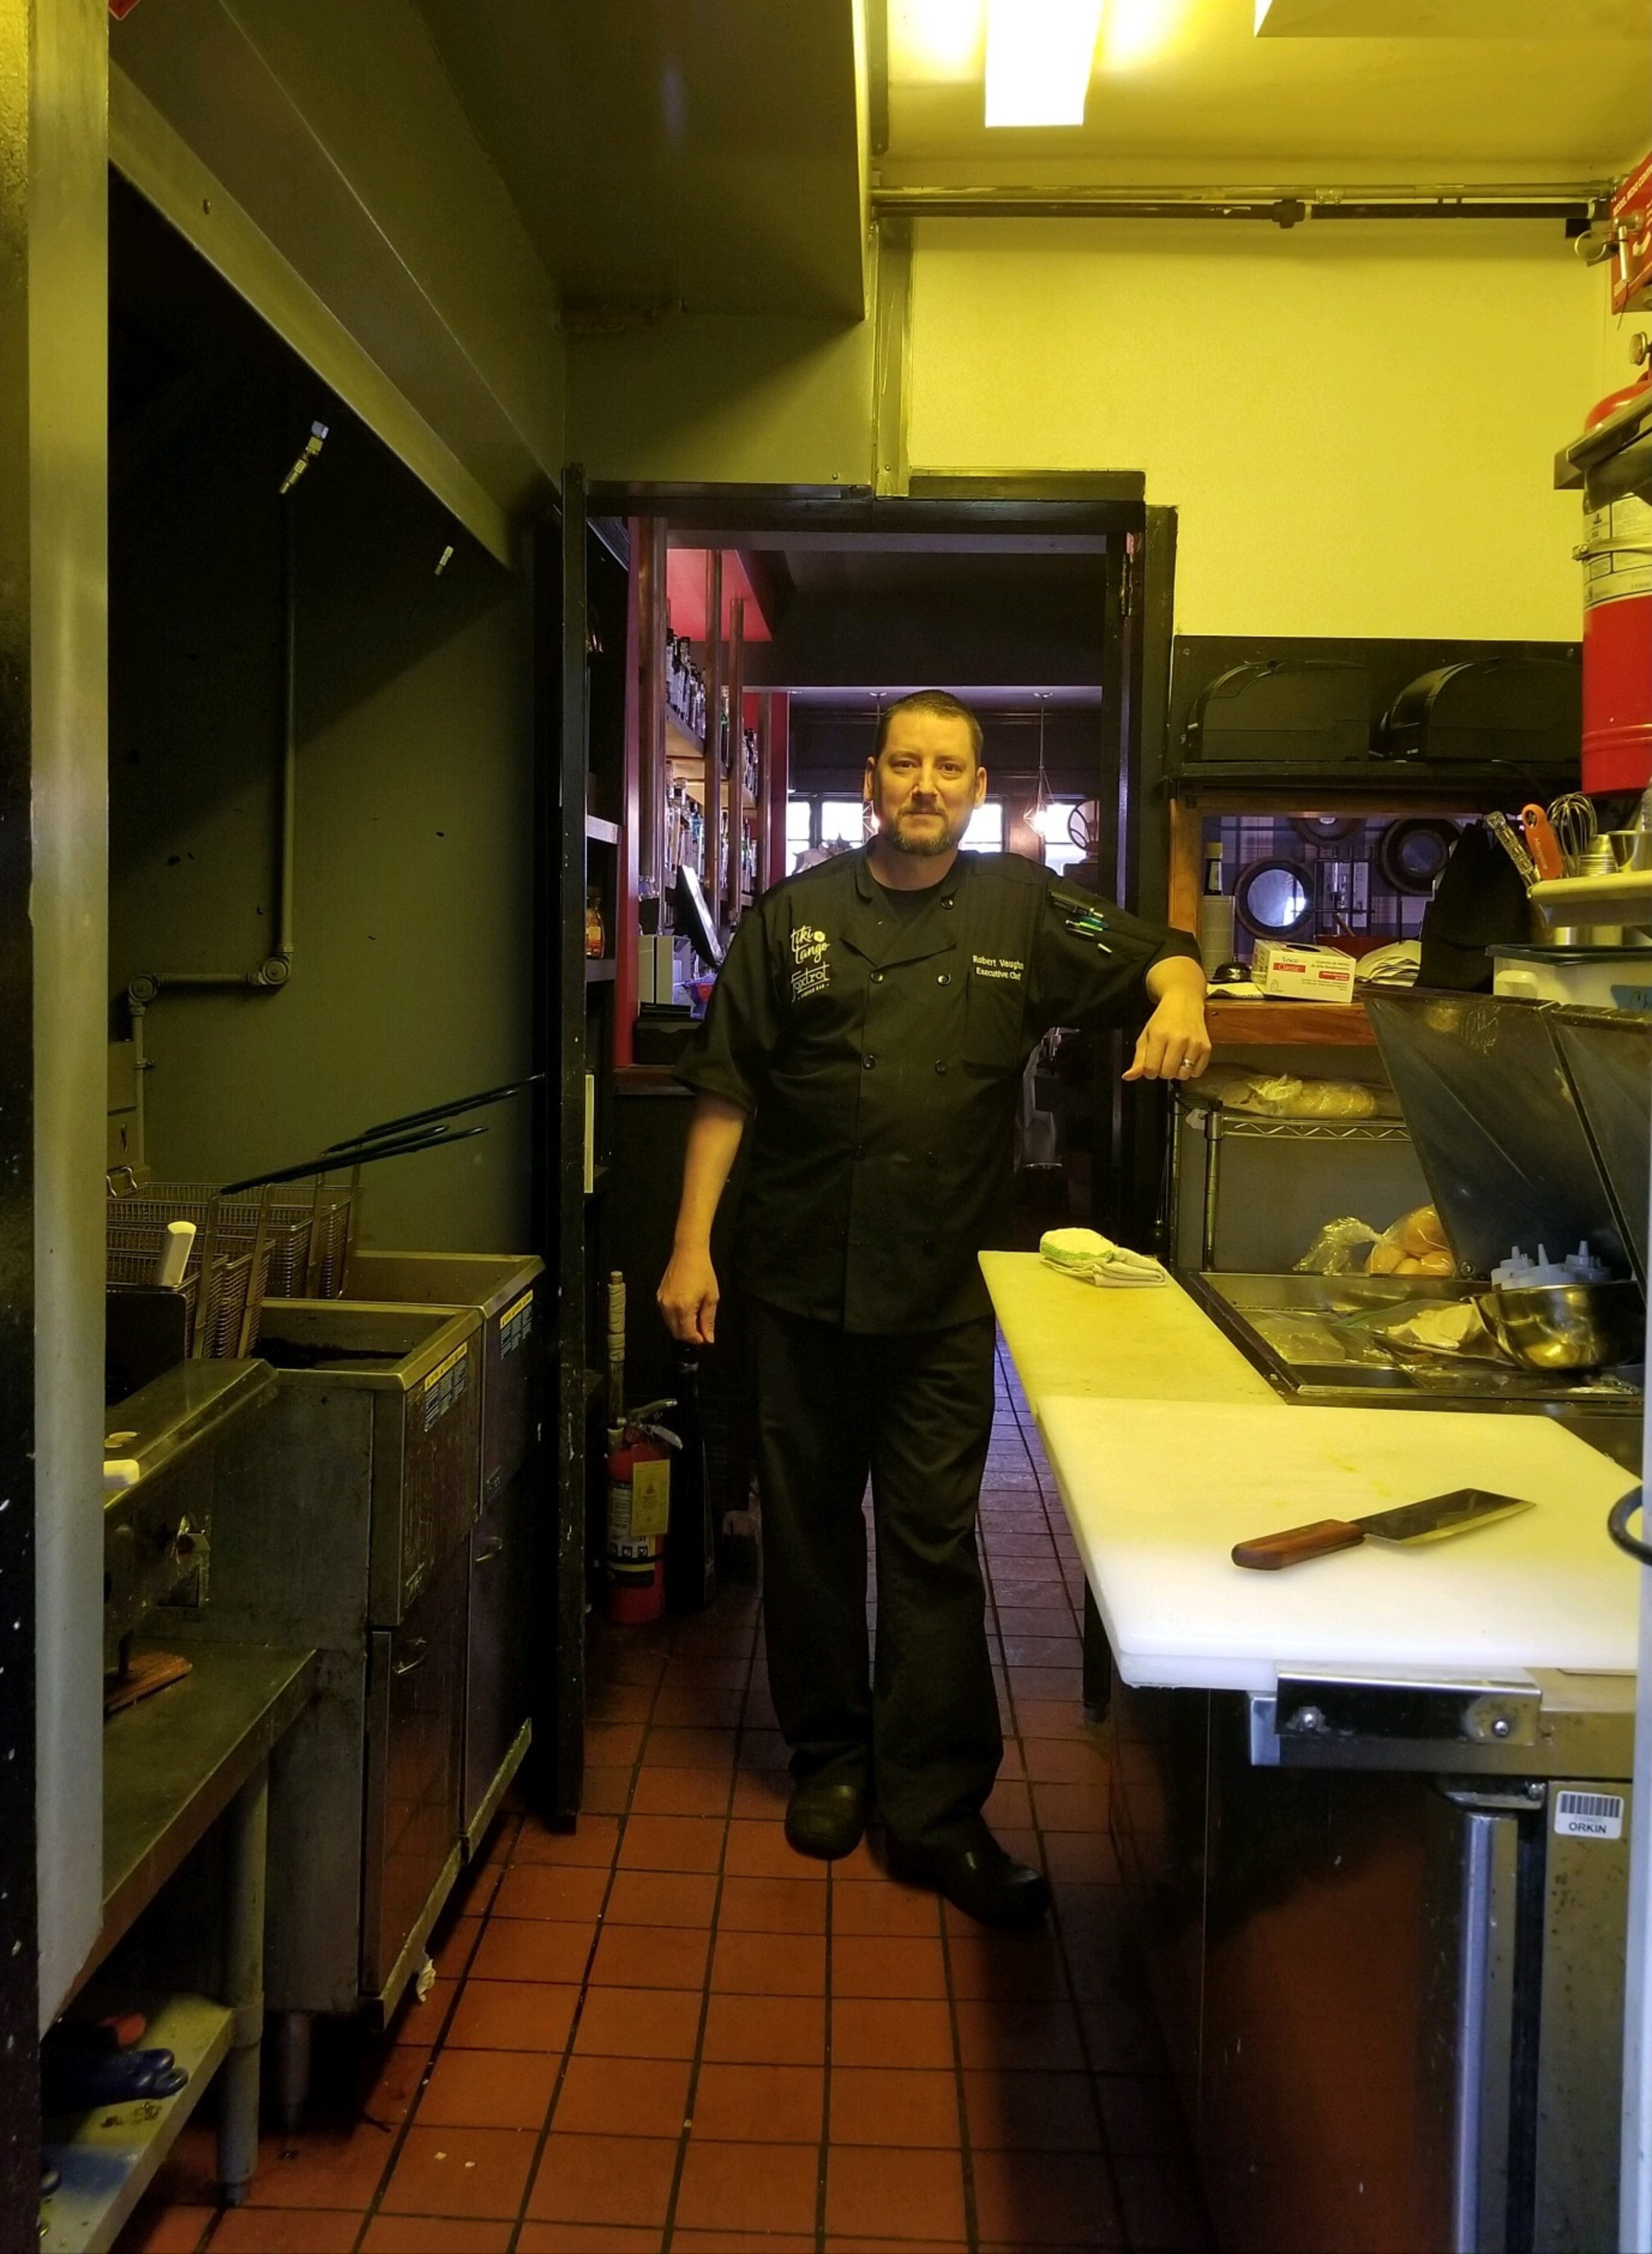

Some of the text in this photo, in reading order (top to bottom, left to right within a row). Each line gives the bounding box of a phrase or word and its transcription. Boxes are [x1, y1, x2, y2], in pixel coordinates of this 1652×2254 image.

[973, 955, 1023, 970] Robert Vaughn
[976, 967, 1009, 978] Executive
[1569, 1822, 1606, 1833] ORKIN
